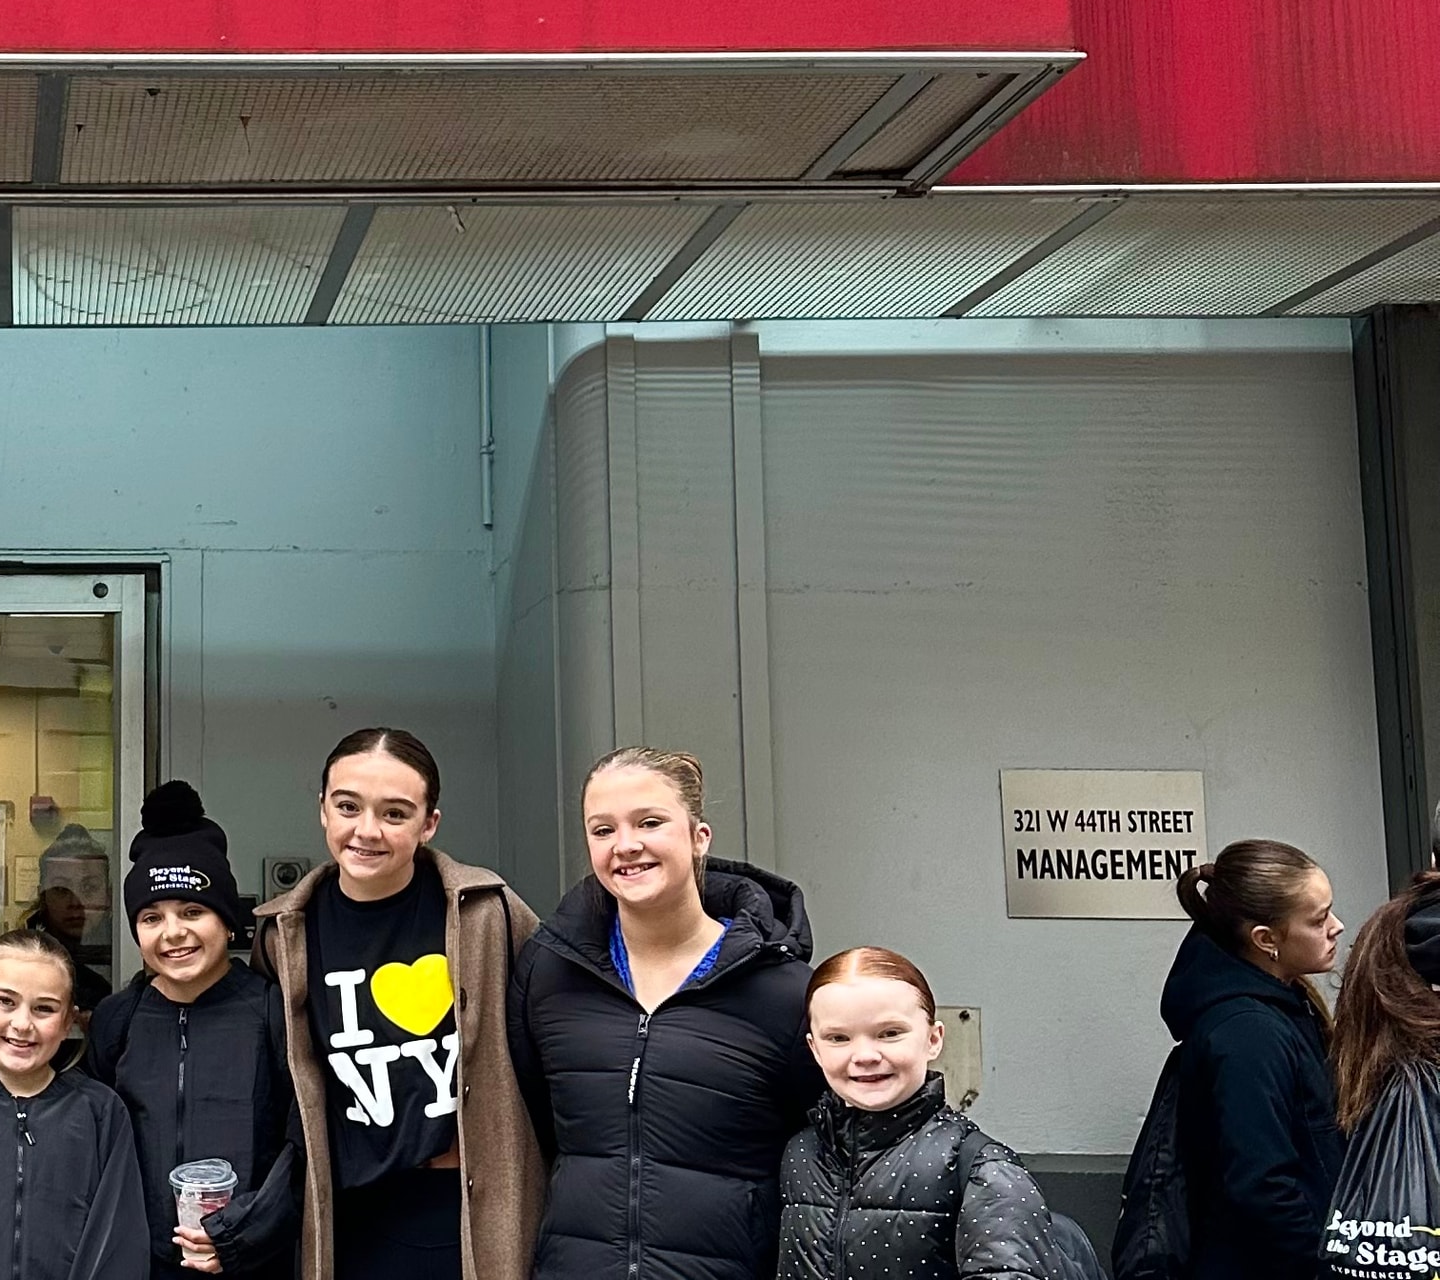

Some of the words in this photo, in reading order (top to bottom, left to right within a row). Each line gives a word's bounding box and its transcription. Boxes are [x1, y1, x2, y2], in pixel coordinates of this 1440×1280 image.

[1014, 810, 1040, 832] 321
[1047, 810, 1069, 832] W
[1075, 810, 1121, 833] 44TH
[1127, 811, 1194, 833] STREET
[1017, 849, 1197, 880] MANAGEMENT
[324, 968, 375, 1049] I
[327, 1030, 460, 1128] NY
[1326, 1239, 1350, 1254] the
